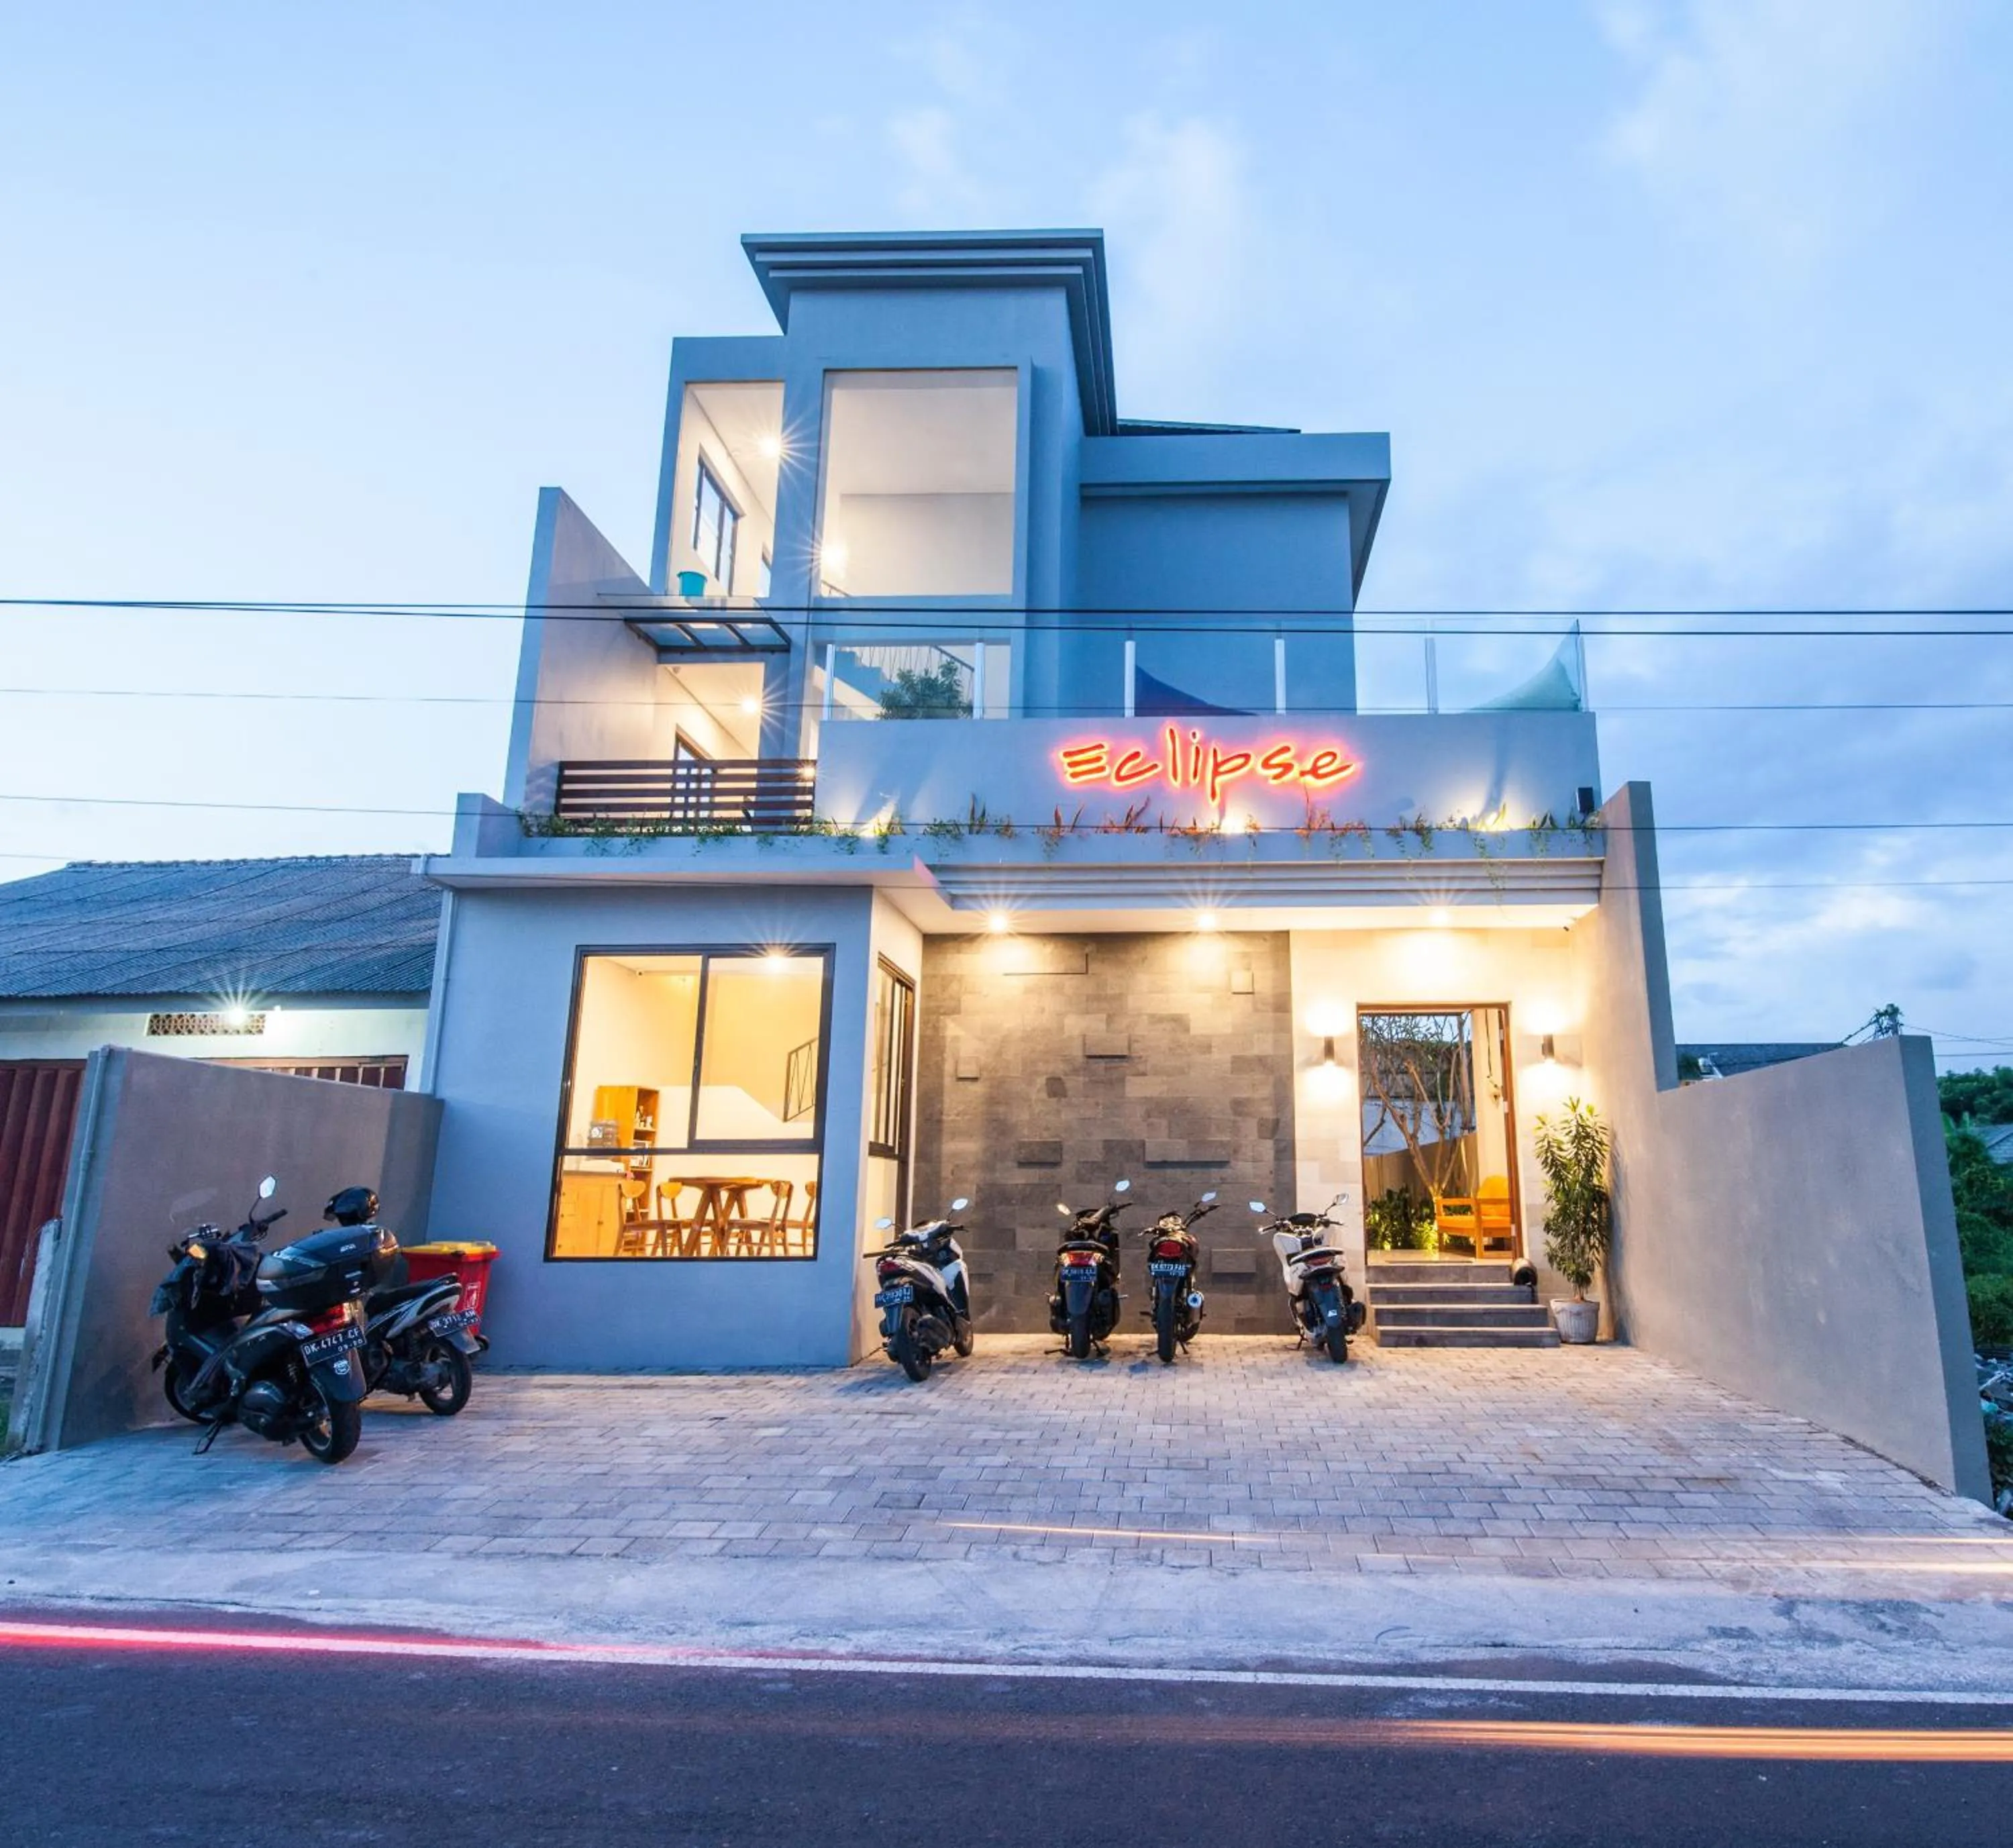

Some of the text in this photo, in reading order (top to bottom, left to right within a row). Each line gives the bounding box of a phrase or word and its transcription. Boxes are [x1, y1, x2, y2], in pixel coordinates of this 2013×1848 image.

[1062, 727, 1354, 803] Eclipse
[304, 1343, 319, 1355] DK
[348, 1327, 359, 1339] CF
